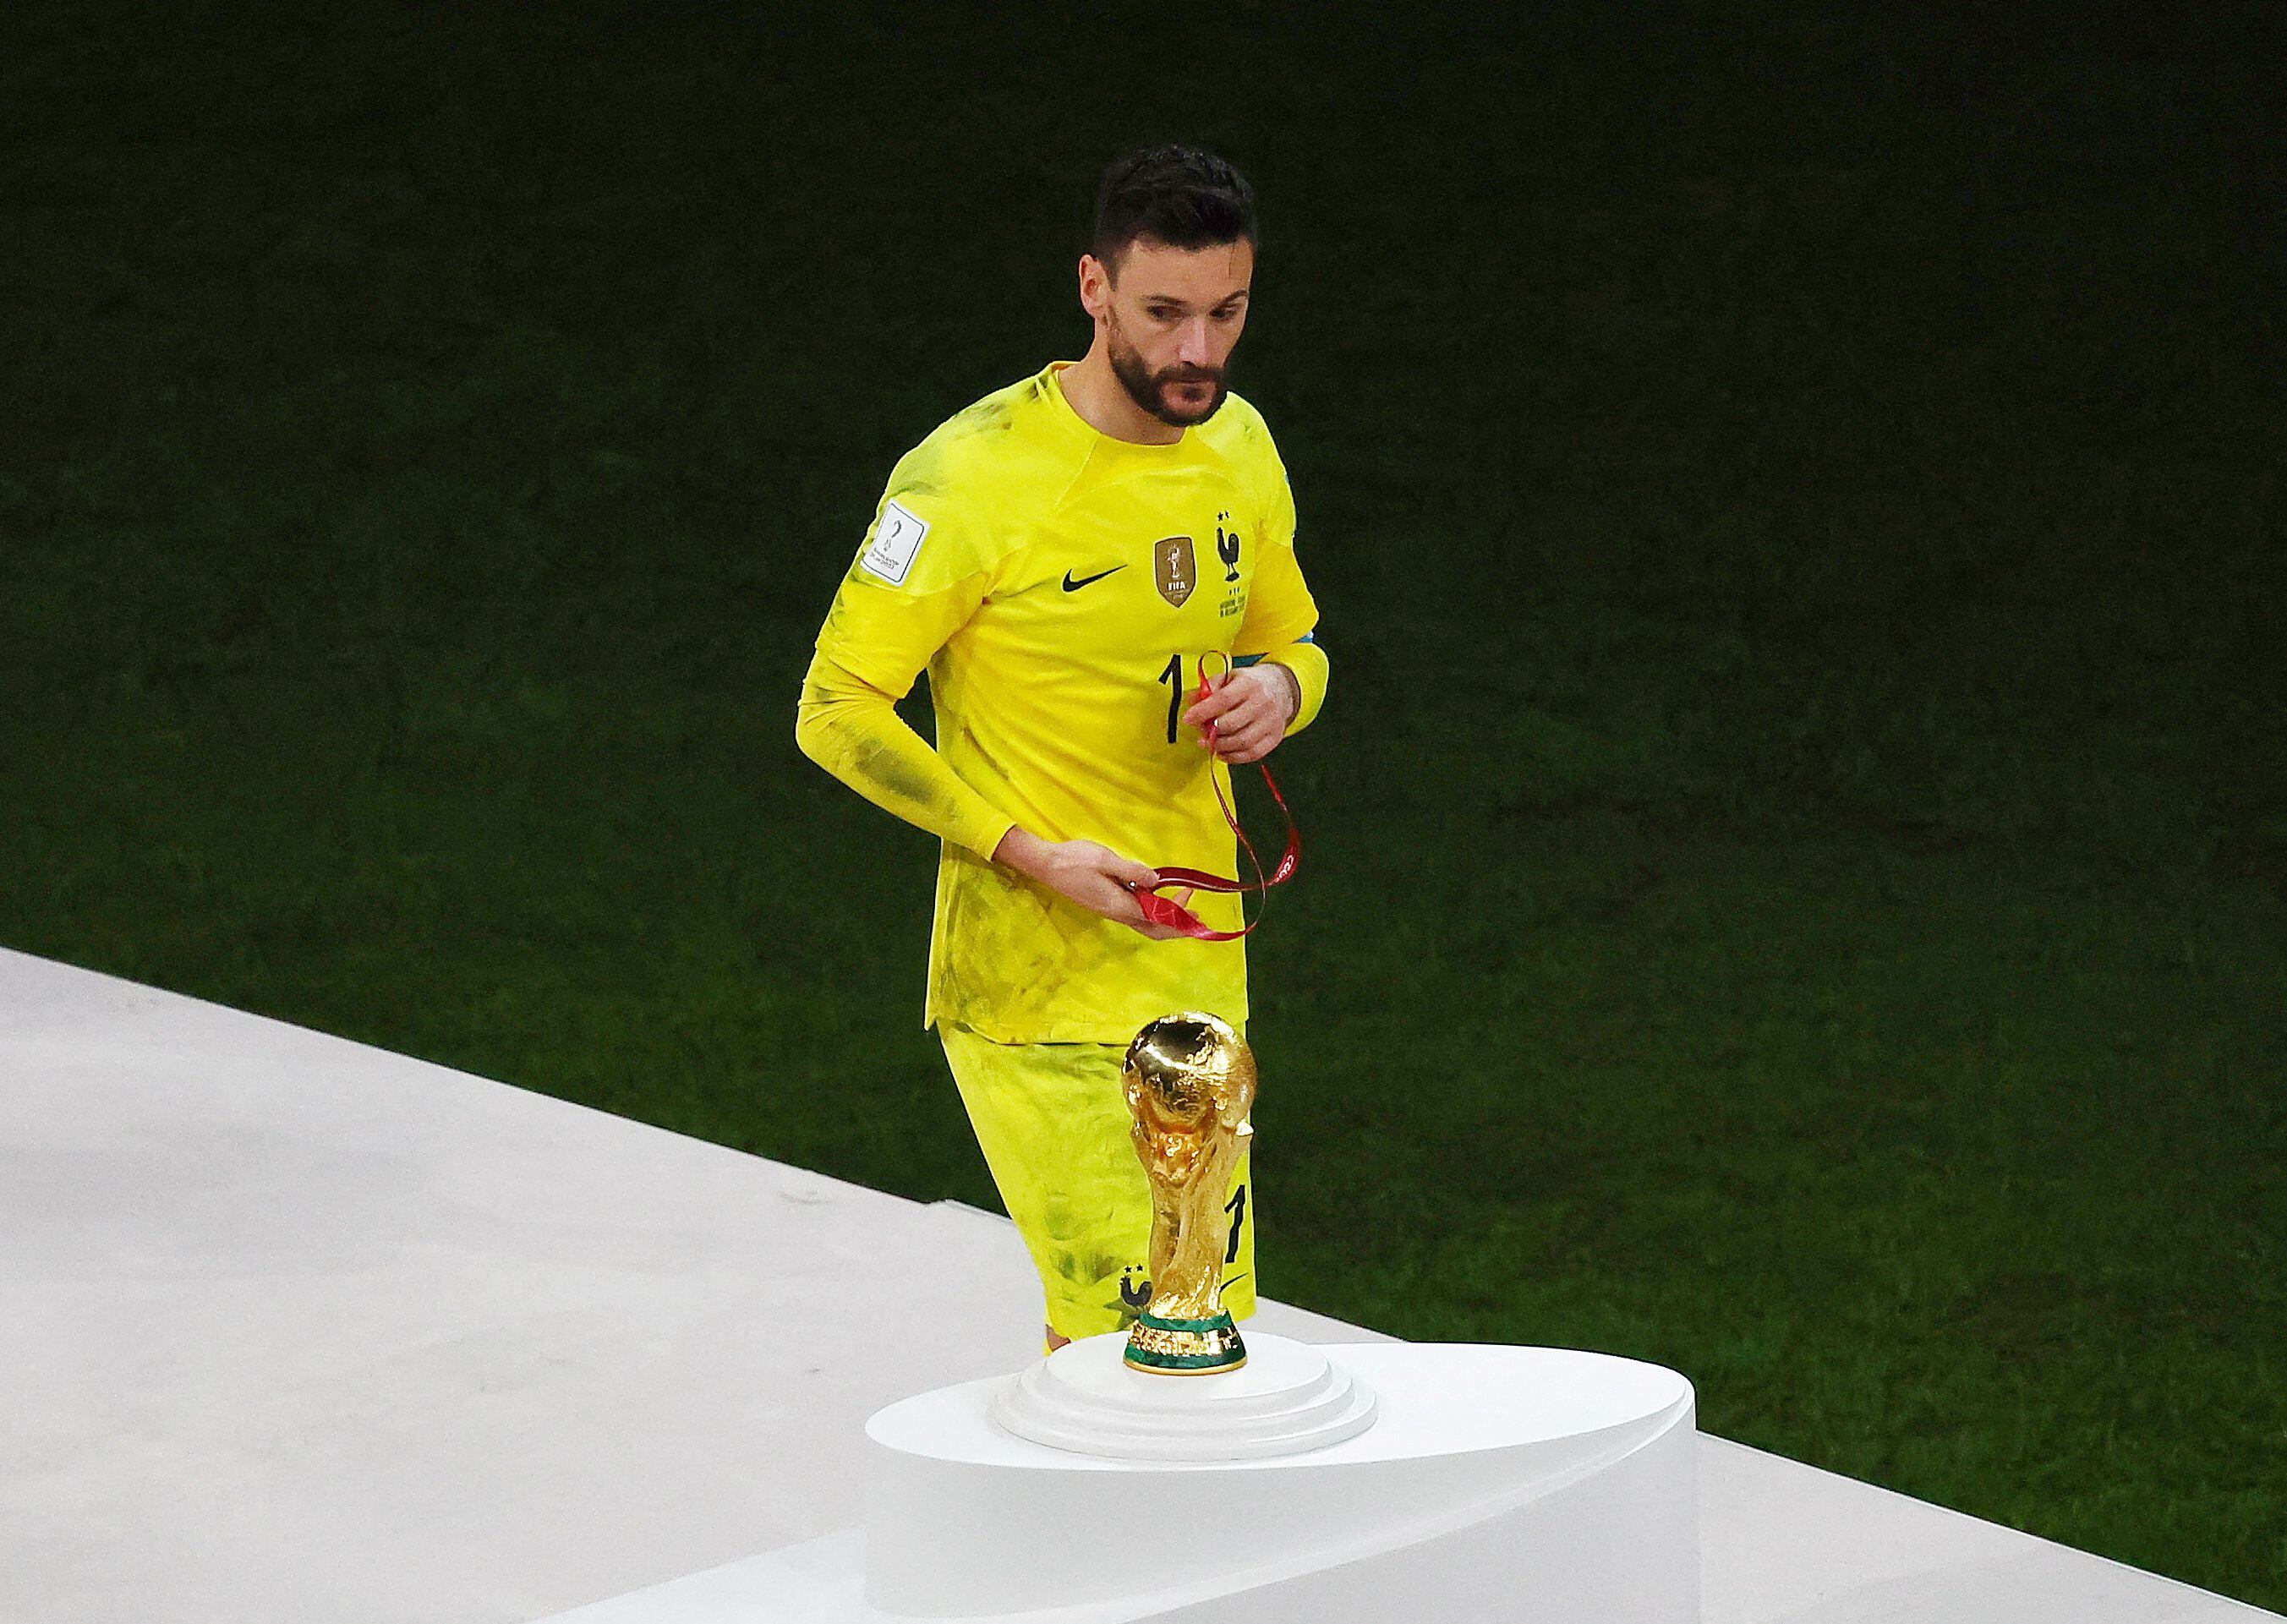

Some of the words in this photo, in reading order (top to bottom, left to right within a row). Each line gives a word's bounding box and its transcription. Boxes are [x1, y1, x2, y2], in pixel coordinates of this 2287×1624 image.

[1168, 581, 1186, 591] FIFA
[1158, 654, 1181, 743] 1
[1224, 1184, 1245, 1263] 1
